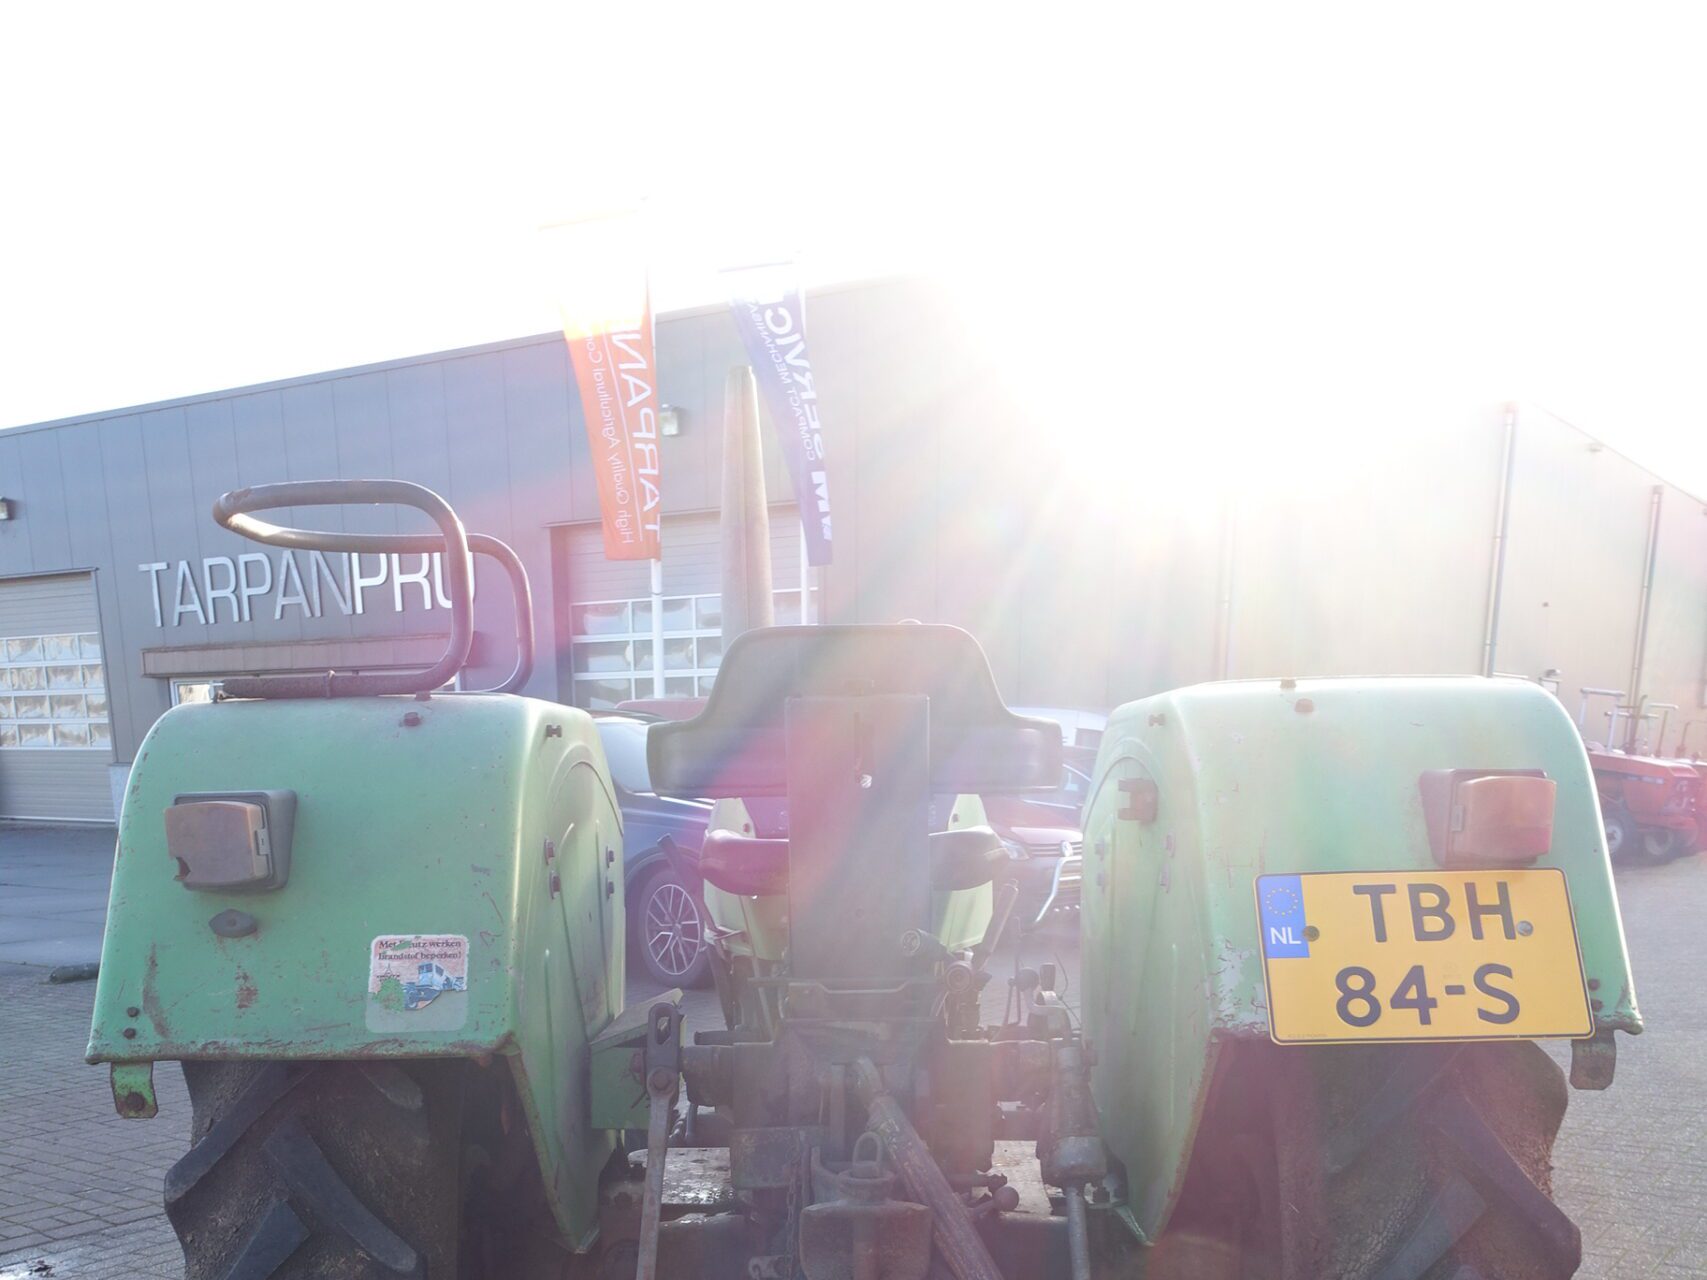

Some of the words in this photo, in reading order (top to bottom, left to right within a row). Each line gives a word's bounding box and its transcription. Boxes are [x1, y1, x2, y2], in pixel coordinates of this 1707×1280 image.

[1270, 926, 1302, 945] NL
[1352, 881, 1517, 943] TBH
[1334, 962, 1521, 1028] 84-S
